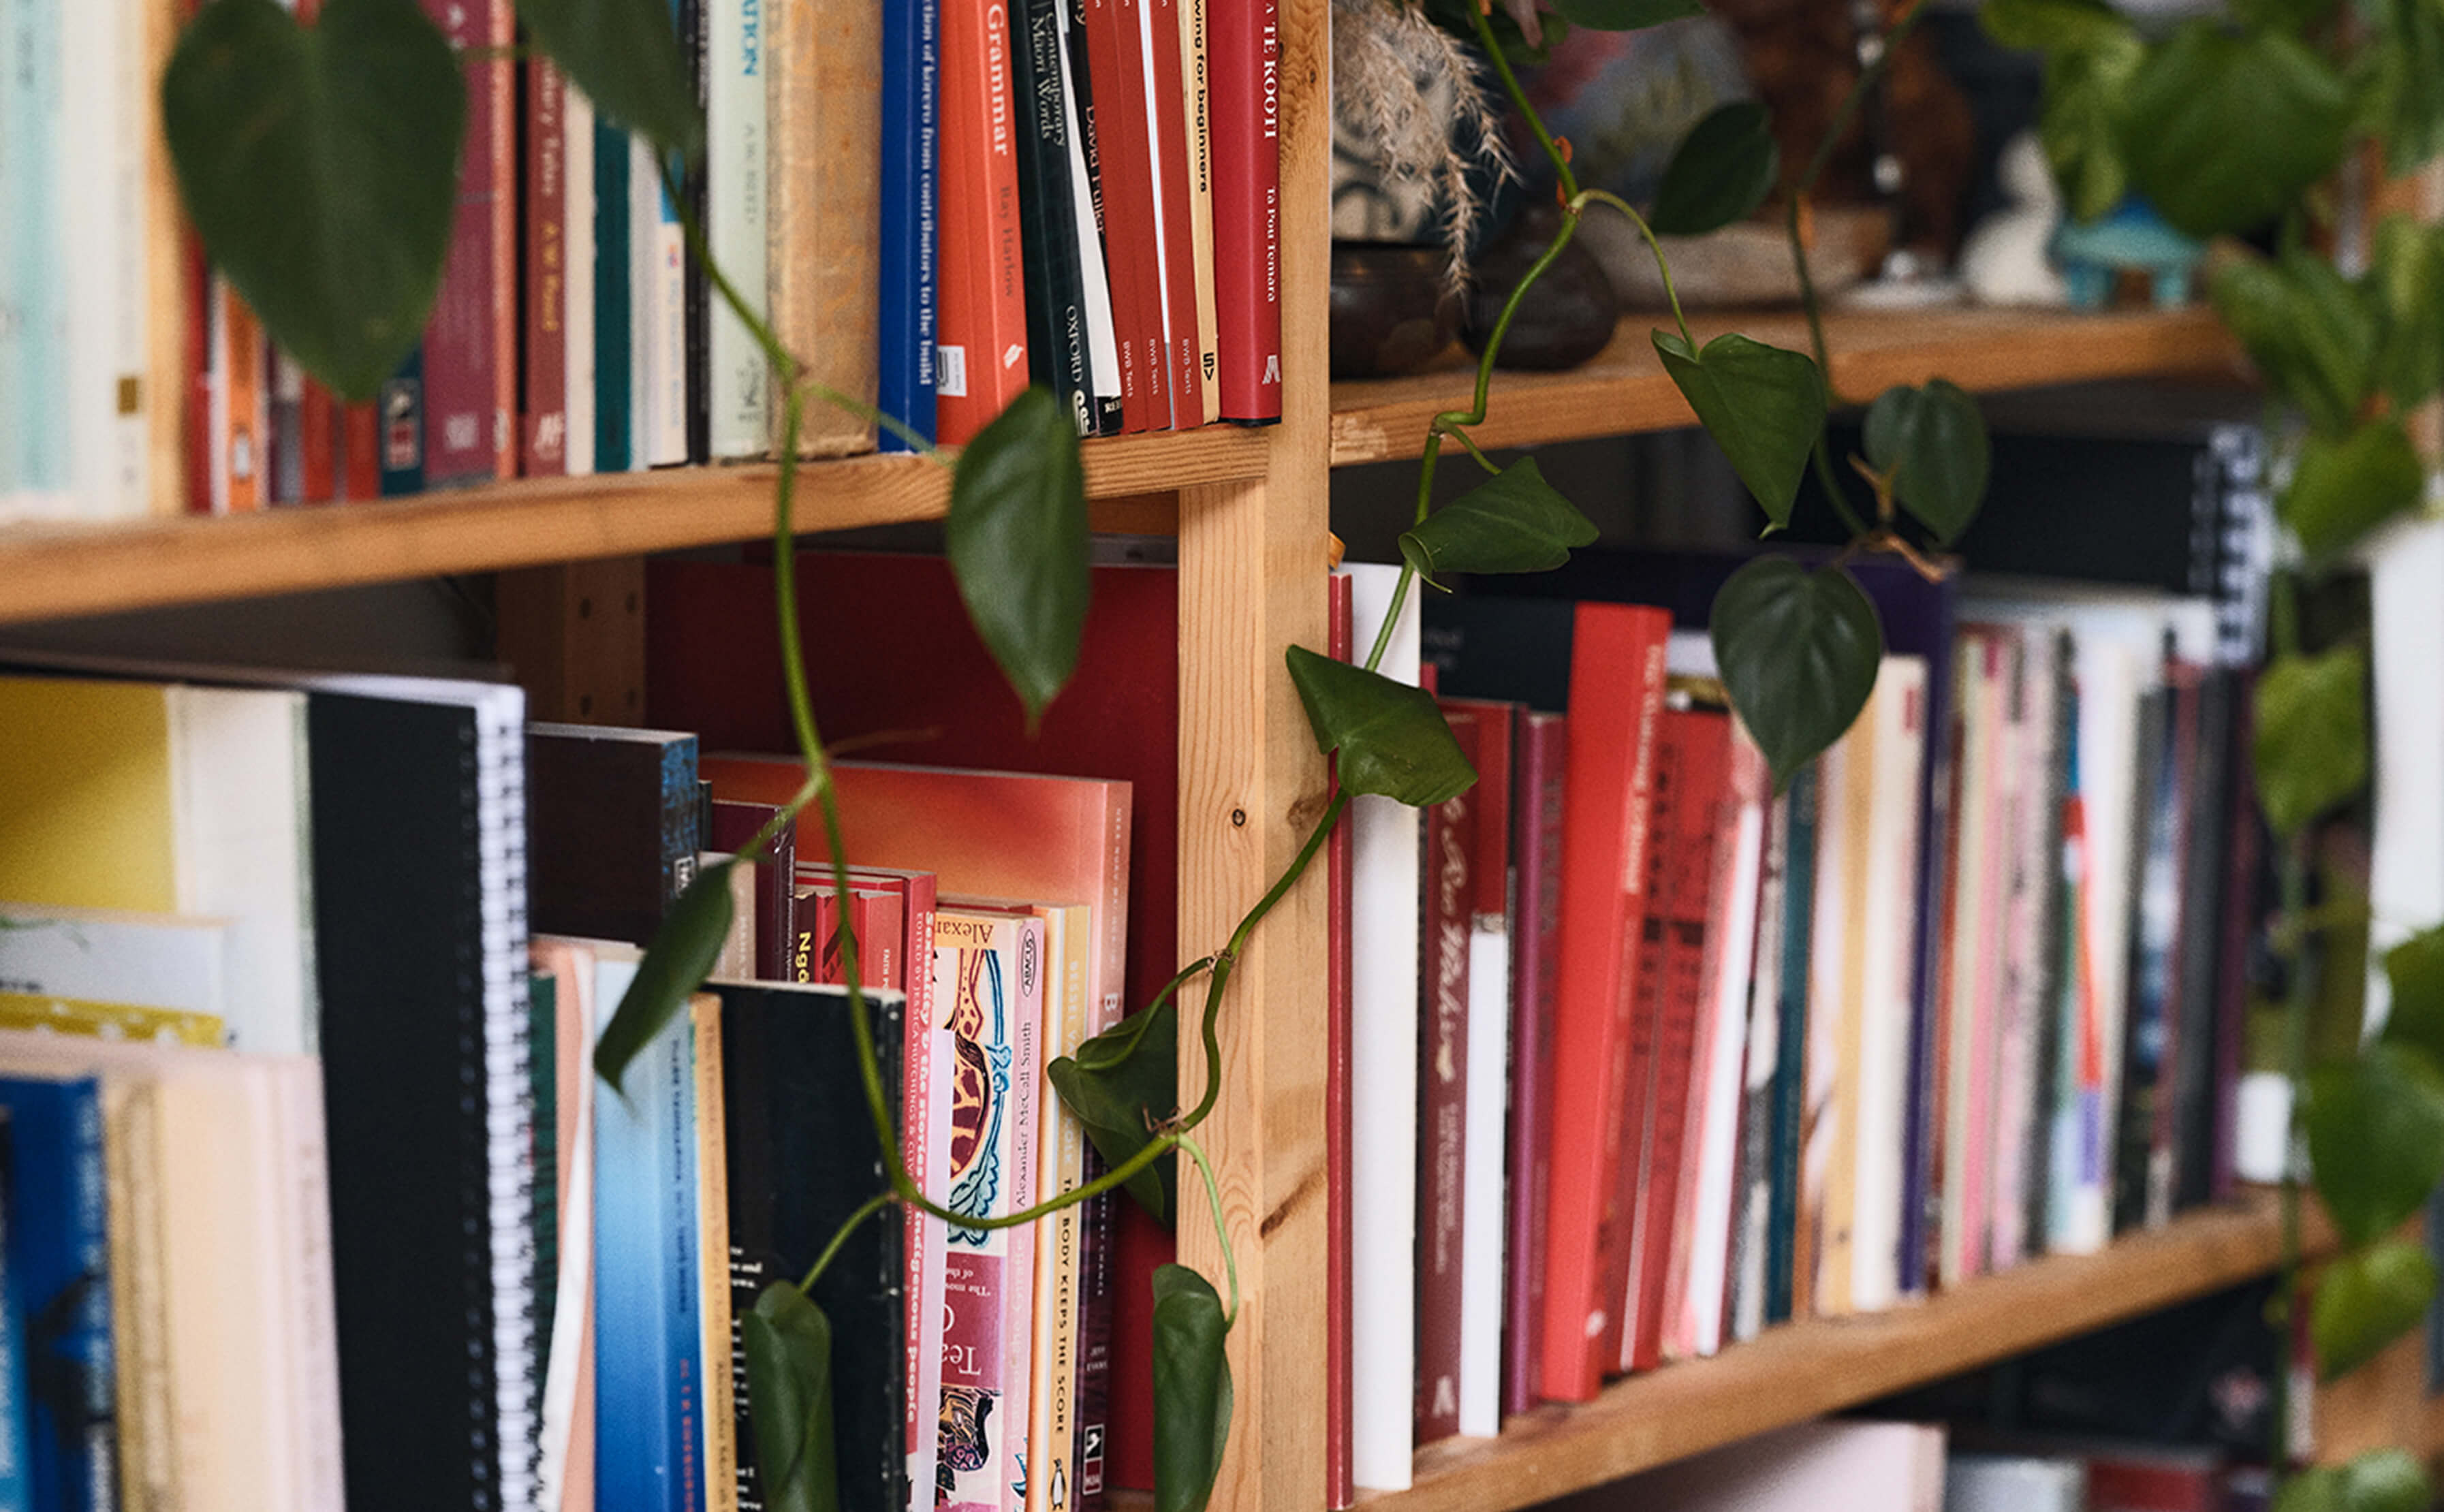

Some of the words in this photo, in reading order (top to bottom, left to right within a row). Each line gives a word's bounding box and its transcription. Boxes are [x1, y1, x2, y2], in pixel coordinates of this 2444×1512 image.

[1264, 22, 1276, 54] TE
[987, 3, 1007, 156] Grammar
[1046, 12, 1067, 146] Contemporary
[1197, 54, 1205, 84] for
[1036, 78, 1054, 139] Words
[1264, 60, 1277, 139] KOOTI
[1197, 89, 1208, 193] beginners
[1267, 208, 1276, 239] Pou
[1065, 305, 1083, 381] OXFORD
[1125, 371, 1135, 397] Texts
[1150, 369, 1159, 395] Texts
[1184, 368, 1193, 395] Texts
[881, 948, 891, 975] FAITH
[915, 913, 923, 961] EDITED
[1024, 938, 1034, 988] ABACUS
[915, 966, 922, 980] BY
[920, 911, 934, 1025] Sexuality
[1067, 961, 1079, 1020] BESSEL
[913, 986, 922, 1039] JESSICA
[1020, 1022, 1031, 1066] Smith
[909, 1043, 918, 1121] HUTCHINGS
[920, 1054, 929, 1092] the
[1018, 1071, 1030, 1126] McCall
[917, 1099, 926, 1177] stories
[1016, 1132, 1029, 1208] Alexander
[1061, 1217, 1071, 1266] BODY
[909, 1211, 925, 1340] indigenous
[1060, 1275, 1069, 1329] KEEPS
[1059, 1336, 1068, 1367] THE
[905, 1346, 918, 1423] people
[1056, 1375, 1067, 1434] SCORE
